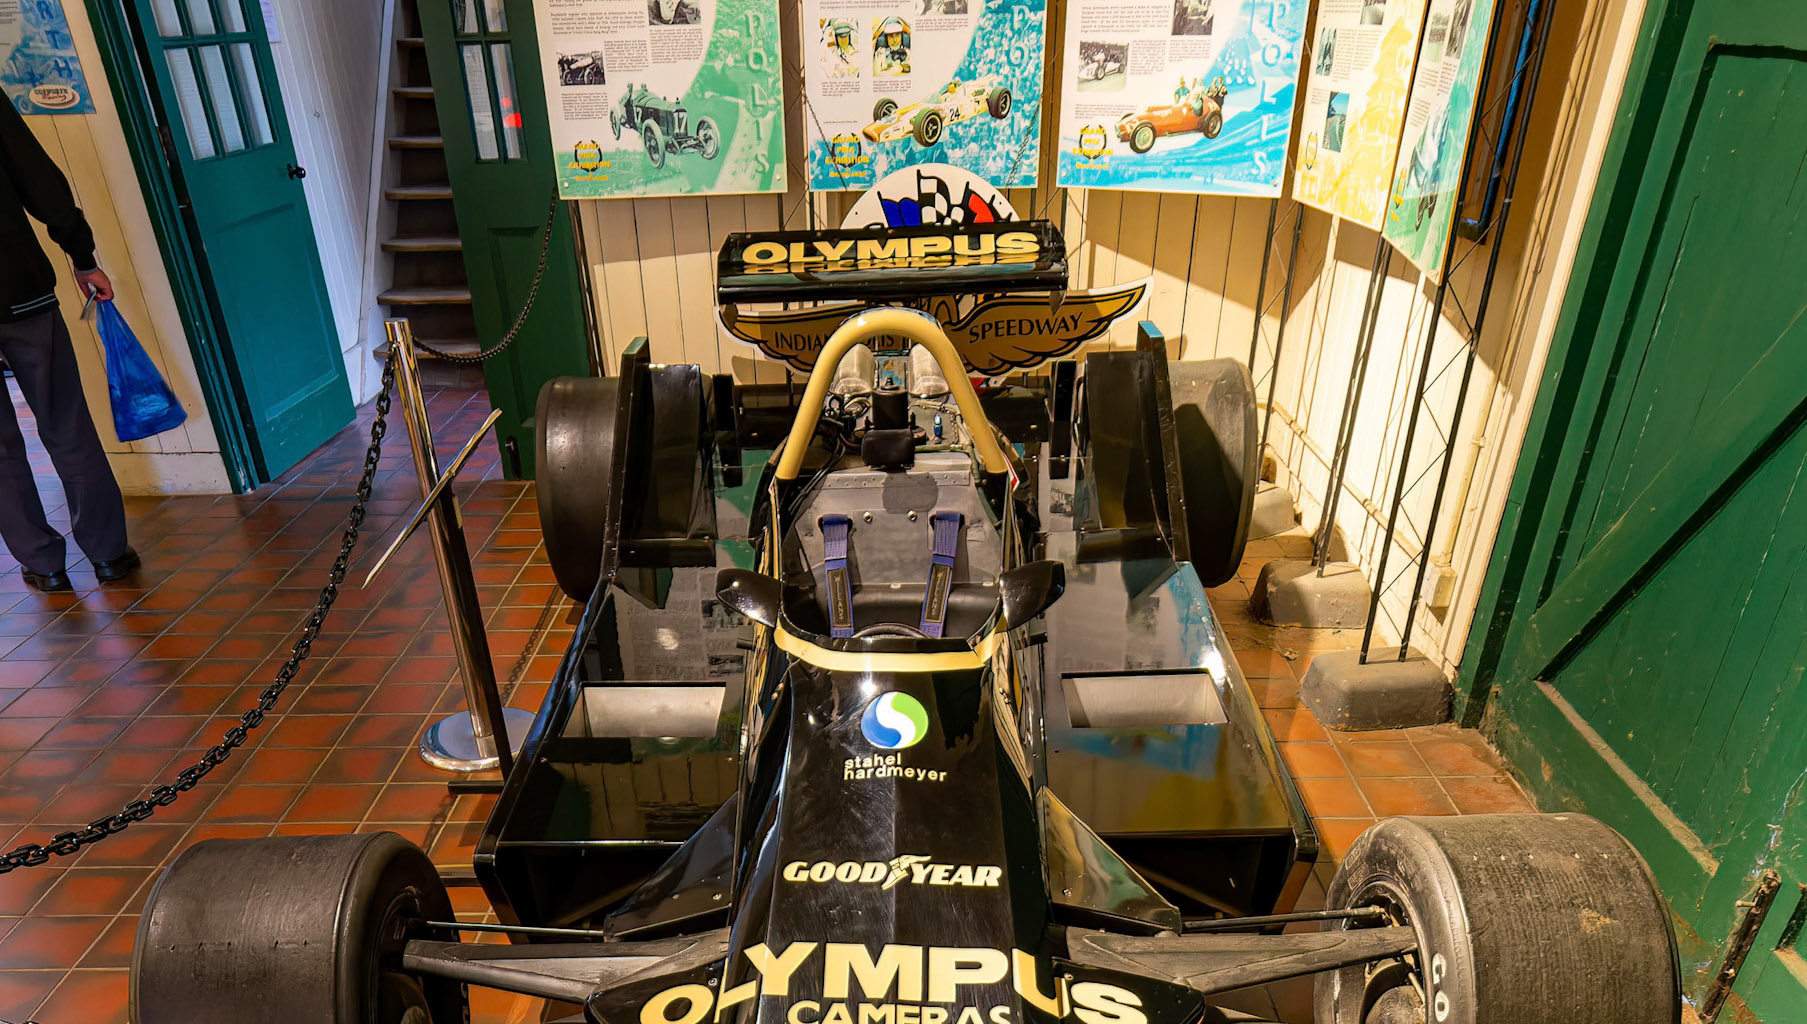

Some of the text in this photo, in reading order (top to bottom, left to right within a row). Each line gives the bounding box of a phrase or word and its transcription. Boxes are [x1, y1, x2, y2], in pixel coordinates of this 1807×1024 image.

[674, 112, 687, 133] 17
[949, 106, 961, 122] 24
[741, 231, 1040, 264] OLYMPUS
[968, 311, 1083, 344] SPEEDWAY
[844, 752, 902, 768] stahel
[843, 767, 947, 782] hardmeyer
